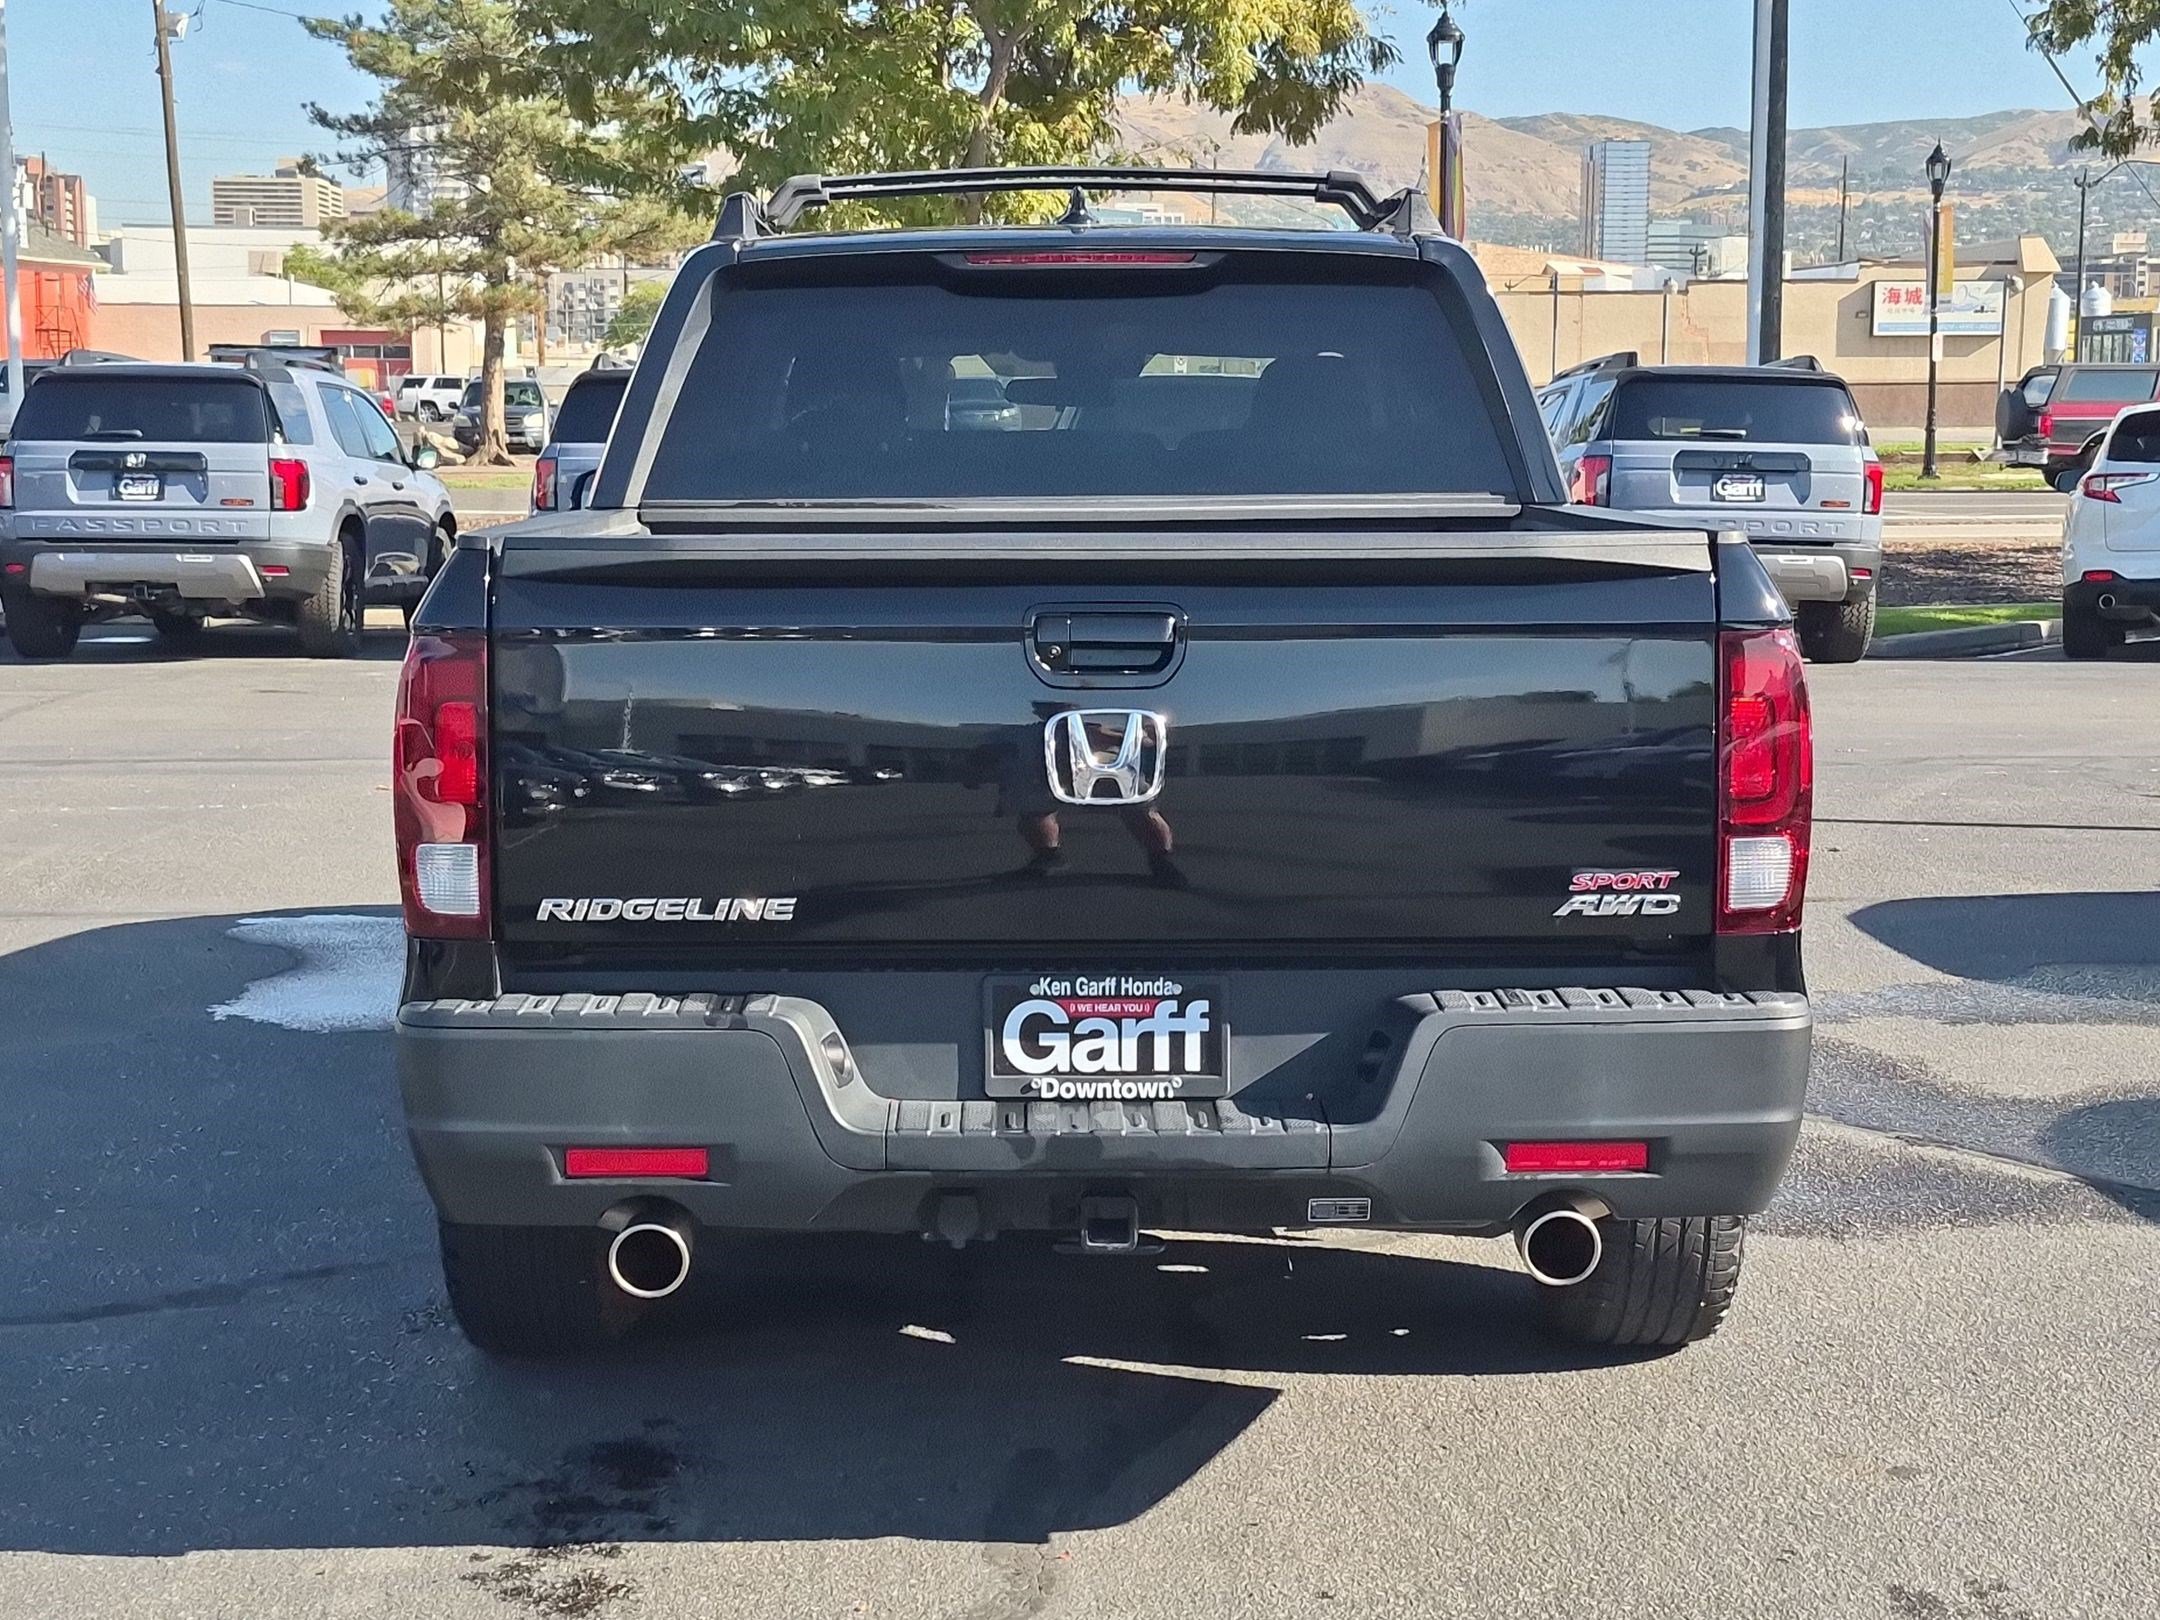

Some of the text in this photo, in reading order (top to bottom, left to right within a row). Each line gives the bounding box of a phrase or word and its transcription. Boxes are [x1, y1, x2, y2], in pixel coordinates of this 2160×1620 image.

[31, 519, 249, 533] PASSPORT
[1568, 871, 1681, 891] SPORT
[535, 897, 798, 922] RIDGELINE
[1552, 894, 1682, 917] AWD
[1039, 976, 1174, 997] Ken Garff Honda
[1076, 1003, 1143, 1013] WE HEAR YOU
[1002, 999, 1210, 1074] Garff
[1039, 1077, 1175, 1099] Downtown
